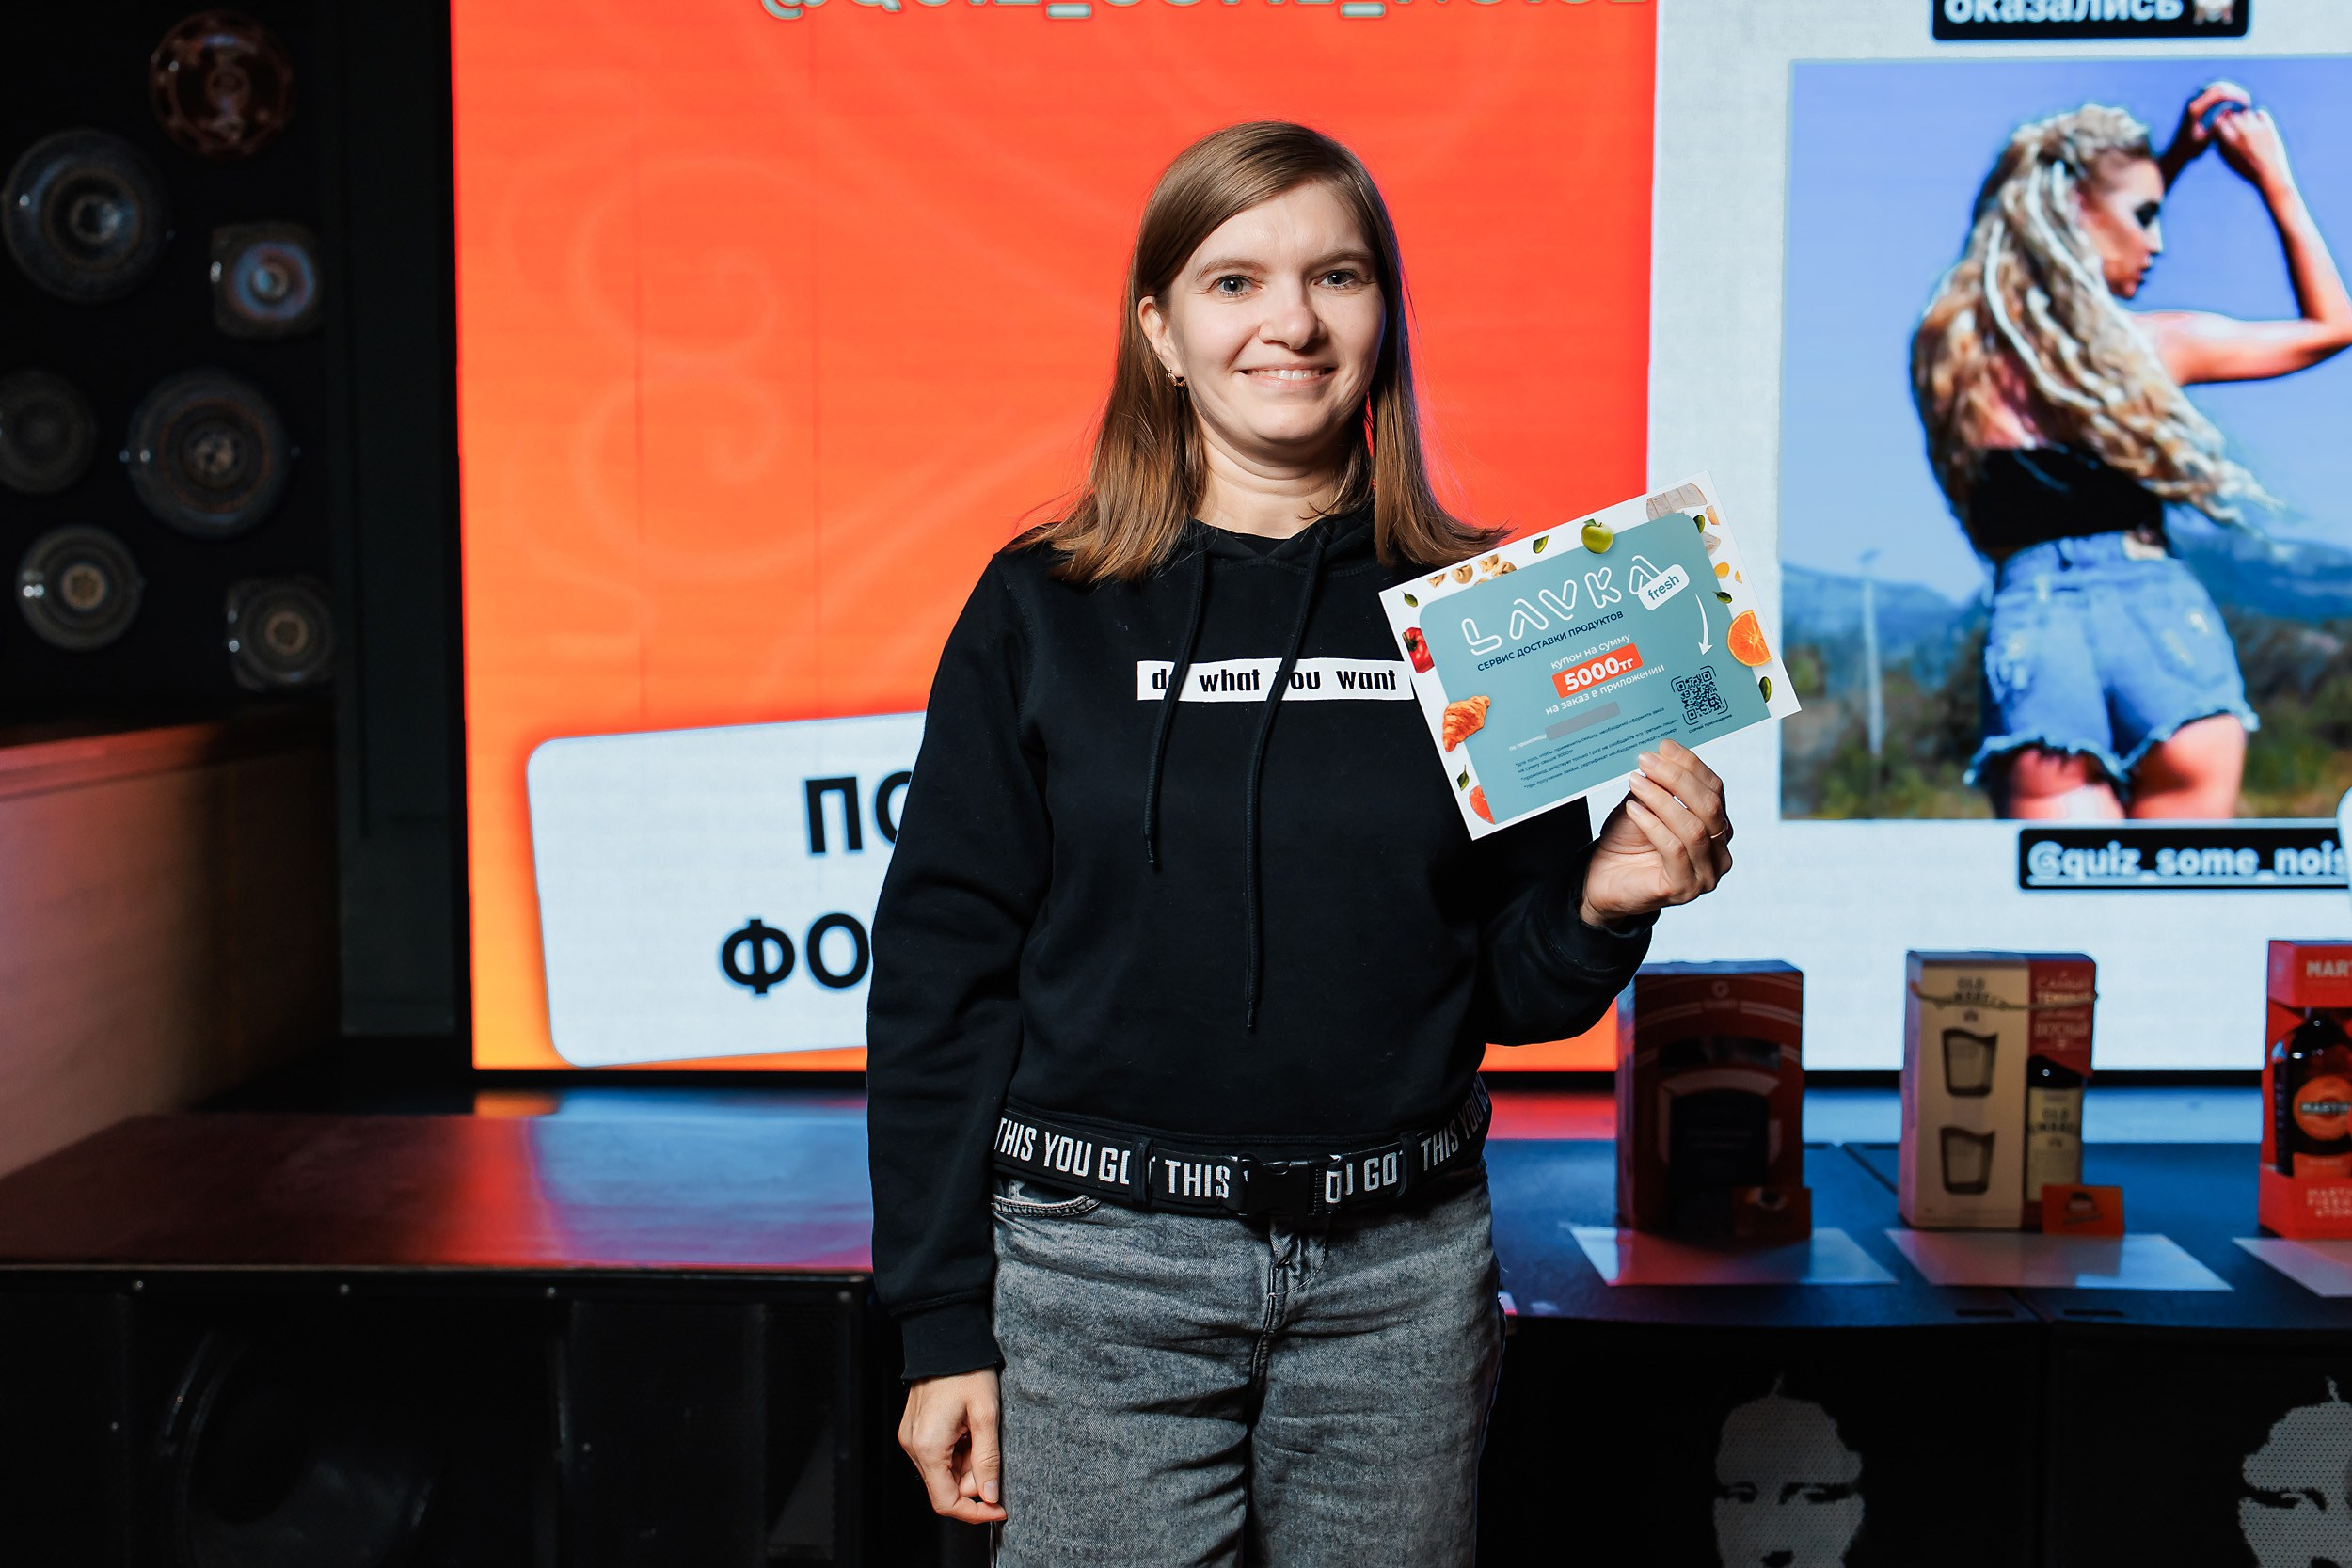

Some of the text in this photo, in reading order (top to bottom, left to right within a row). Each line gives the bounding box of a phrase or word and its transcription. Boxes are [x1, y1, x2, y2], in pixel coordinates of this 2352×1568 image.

[1461, 555, 1662, 656] LAVKA
[1647, 574, 1680, 601] fresh
[1477, 610, 1624, 672] СЕРВИС ДОСТАВКИ ПРОДУКТОВ
[1550, 633, 1632, 670] купон на сумму
[1152, 669, 1396, 692] d what ou want
[1545, 664, 1665, 715] на заказ в приложении
[1564, 657, 1633, 691] 5000тг
[1043, 1132, 1092, 1177] YOU
[1421, 1119, 1459, 1172] THIS
[1165, 1159, 1231, 1198] THIS
[1364, 1150, 1404, 1192] GO
